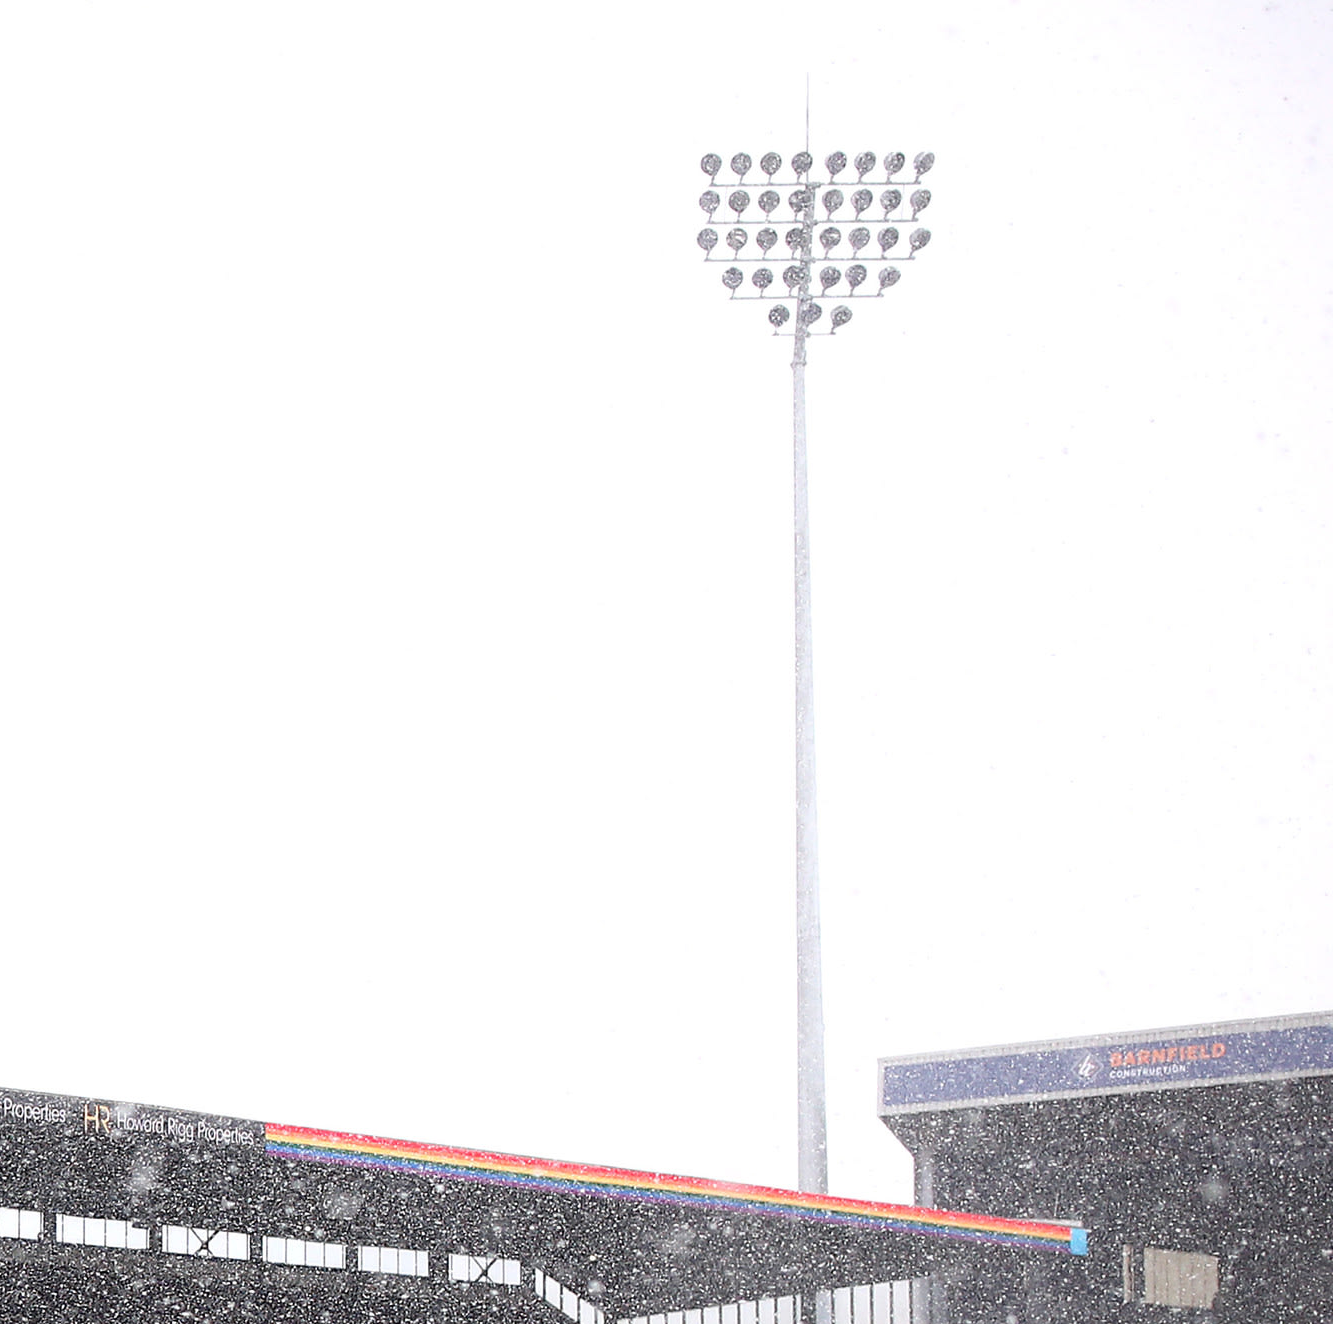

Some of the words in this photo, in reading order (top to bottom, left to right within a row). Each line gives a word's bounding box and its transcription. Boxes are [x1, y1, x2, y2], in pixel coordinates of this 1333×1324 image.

[1110, 1043, 1227, 1068] BARNFIELD
[1109, 1064, 1186, 1080] CONSTRUCTION
[4, 1097, 66, 1123] Properties
[84, 1103, 110, 1134] HR
[117, 1111, 165, 1135] Howard
[168, 1117, 194, 1143] Rigg
[198, 1121, 255, 1146] Properties
